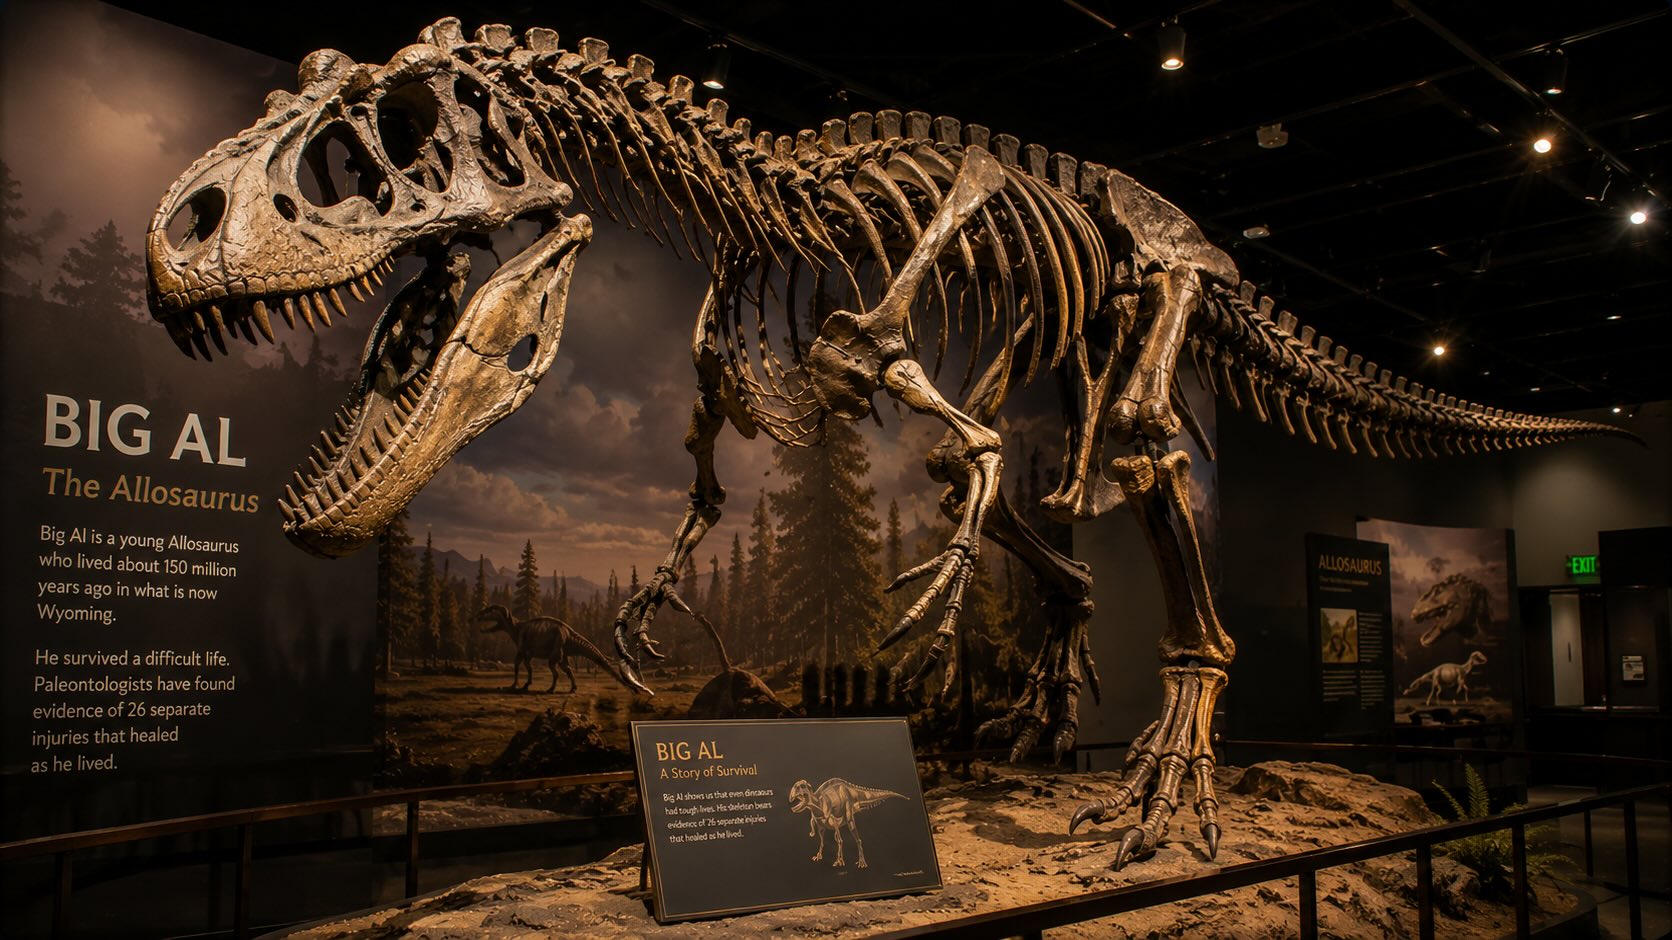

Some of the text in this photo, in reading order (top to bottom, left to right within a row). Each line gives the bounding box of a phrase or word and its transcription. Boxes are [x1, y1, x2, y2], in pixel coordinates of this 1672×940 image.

[44, 394, 247, 467] BIG AL
[43, 468, 259, 513] The Allosaurus
[40, 525, 239, 554] Big Al is a young Allosaurus
[39, 551, 236, 577] who lived about 150 million
[1319, 554, 1382, 575] ALLOSAURUS
[1572, 556, 1596, 574] EXIT
[38, 580, 217, 600] years ago in what is now
[37, 604, 117, 625] Wyoming.
[35, 649, 230, 667] He survived a difficult life.
[34, 675, 235, 695] Paleontologists have found
[33, 701, 211, 721] evidence of 26 separate
[32, 726, 178, 750] injuries that healed
[656, 741, 724, 761] BIG AL
[31, 754, 118, 773] as he lived.
[660, 763, 758, 781] A Story of Survival
[662, 793, 675, 804] Big
[714, 790, 728, 799] that
[728, 790, 744, 798] even
[664, 807, 678, 815] had
[707, 817, 717, 827] 26
[669, 834, 685, 843] that
[717, 831, 726, 839] he
